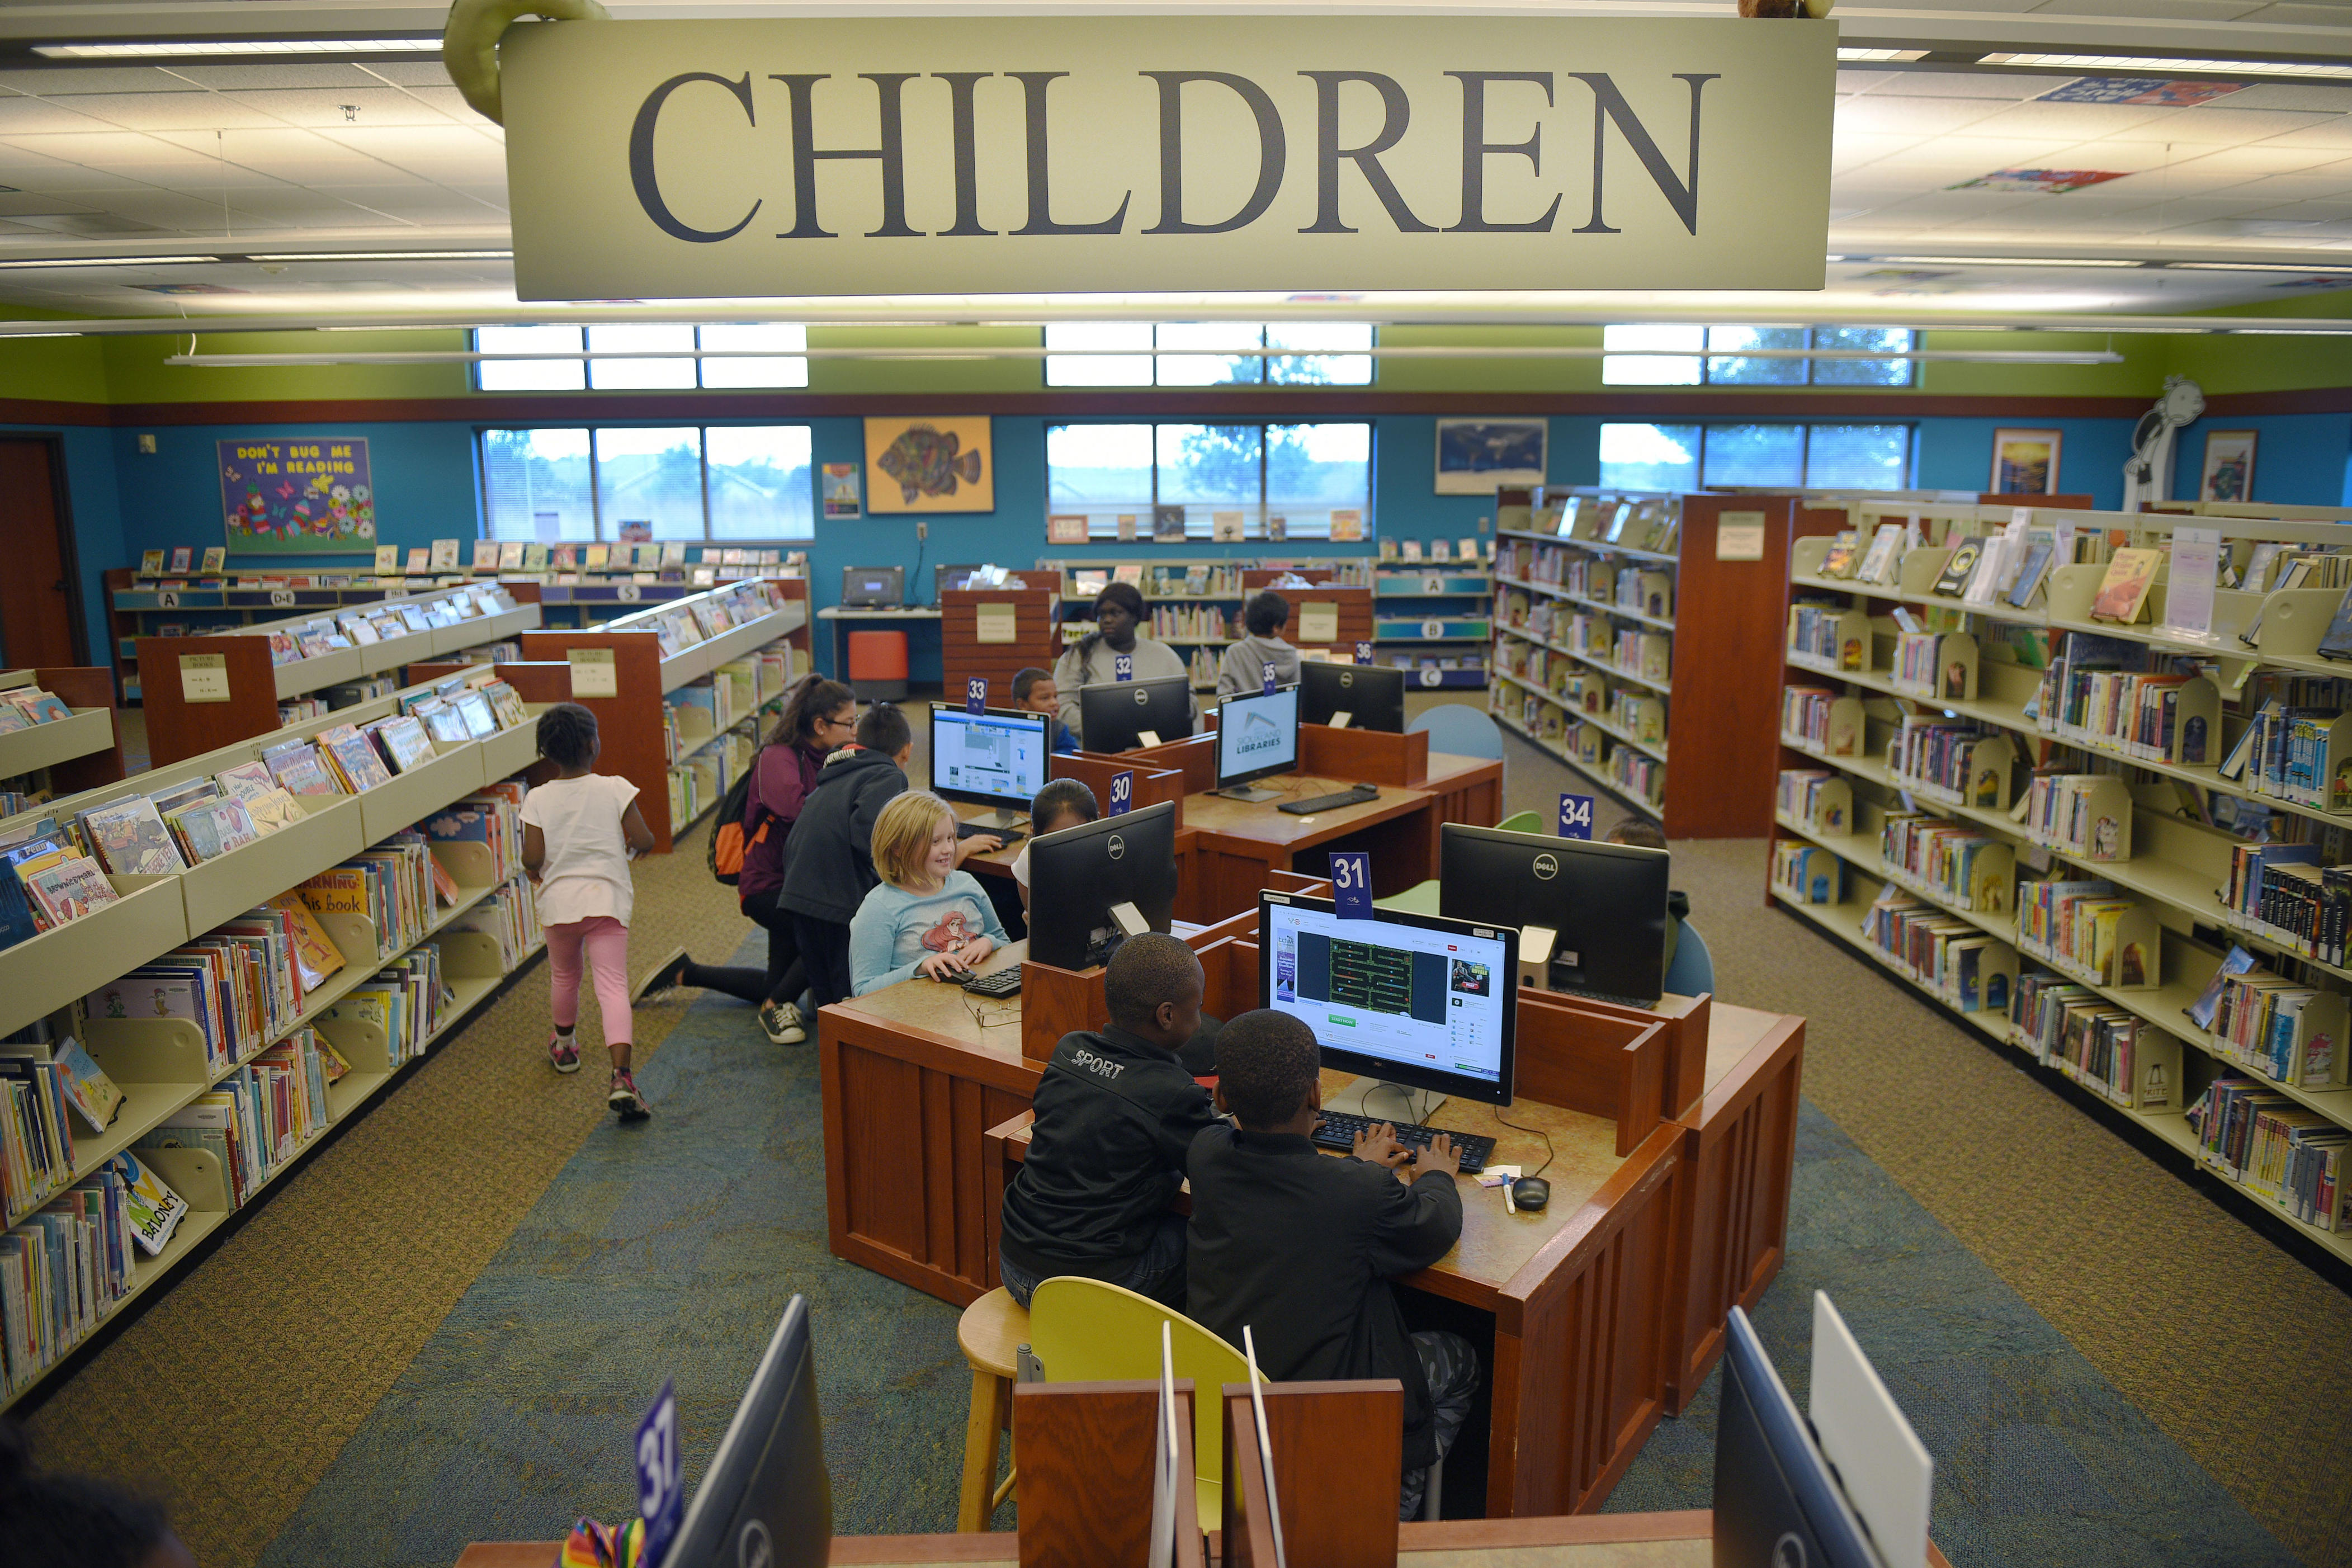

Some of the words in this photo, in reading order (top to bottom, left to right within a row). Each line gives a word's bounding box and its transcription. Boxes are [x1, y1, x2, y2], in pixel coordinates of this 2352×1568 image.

[629, 70, 1721, 243] CHILDREN
[237, 443, 280, 459] DON'T
[290, 445, 320, 458] BUG
[331, 445, 351, 457] ME
[257, 461, 278, 474] I'M
[286, 461, 355, 474] READING
[625, 586, 633, 600] S
[1429, 580, 1439, 591] A
[164, 593, 176, 607] A
[274, 592, 292, 603] D-E
[1429, 625, 1437, 635] B
[1357, 643, 1372, 659] 36
[1116, 657, 1131, 674] 32
[1263, 664, 1275, 682] 35
[1427, 672, 1435, 682] C
[969, 680, 985, 700] 33
[1237, 738, 1281, 754] LIBRARIES
[237, 784, 255, 800] ROUBLE
[1112, 776, 1130, 803] 30
[1561, 798, 1590, 827] 34
[1110, 843, 1122, 852] DELL
[1335, 858, 1364, 889] 31
[1536, 863, 1555, 872] DELL
[294, 875, 360, 890] ARNING:
[299, 893, 322, 911] his
[327, 893, 360, 911] book
[1071, 1050, 1125, 1079] SPORT
[142, 1190, 178, 1241] BALONEY
[639, 1397, 674, 1519] 31
